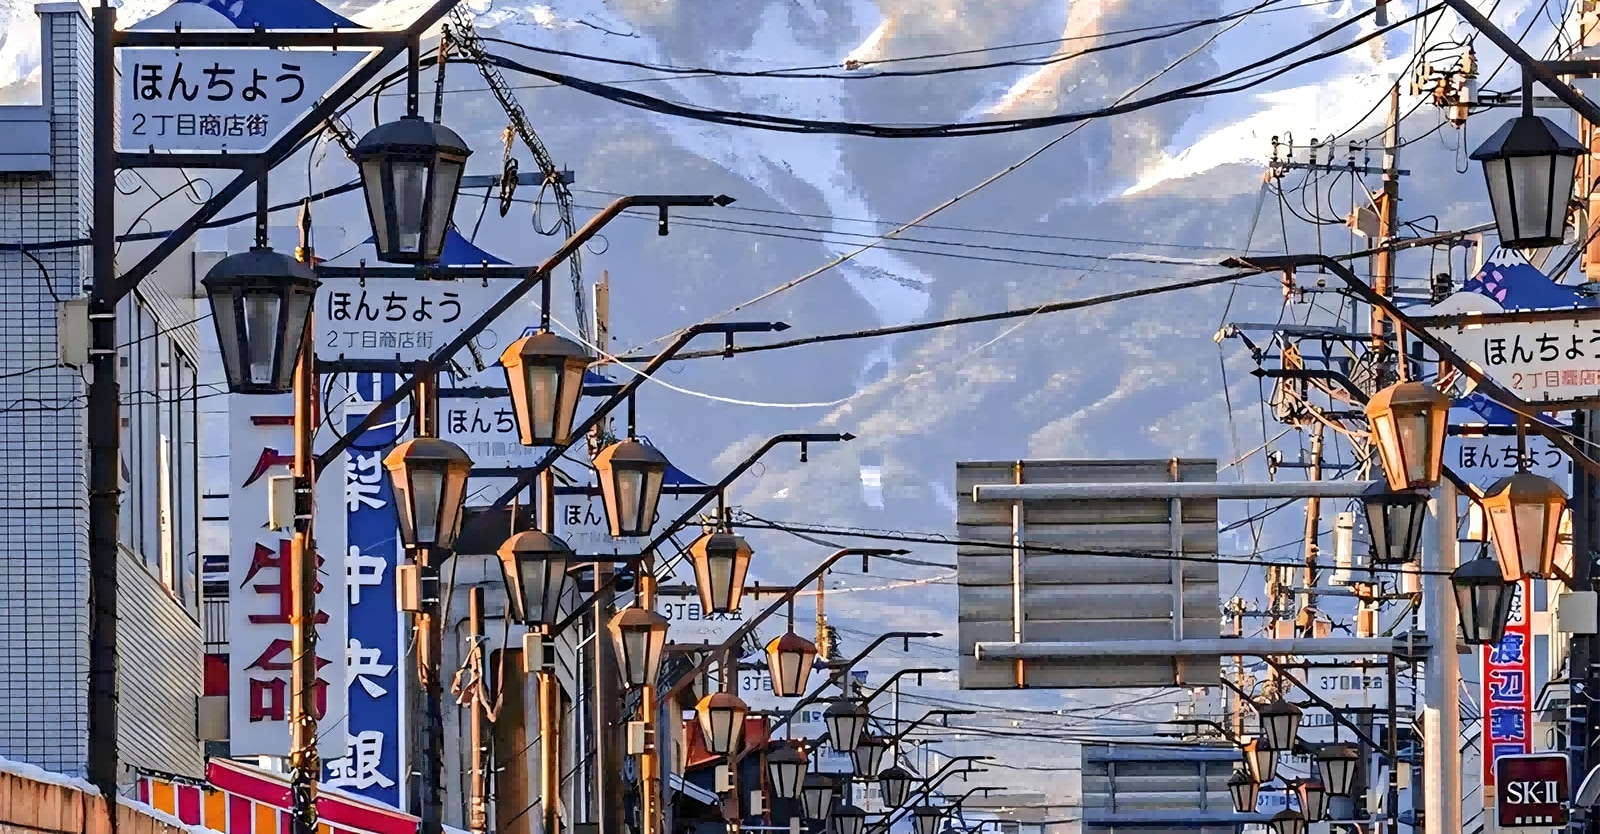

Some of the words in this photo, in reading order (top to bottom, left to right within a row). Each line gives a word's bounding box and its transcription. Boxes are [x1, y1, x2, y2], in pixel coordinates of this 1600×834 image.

[133, 62, 305, 103] ほんちょう
[132, 113, 269, 137] 2丁目商店街
[328, 290, 461, 323] ほんちょう
[1490, 633, 1525, 755] 渡辺薬
[1506, 780, 1559, 804] SK-II
